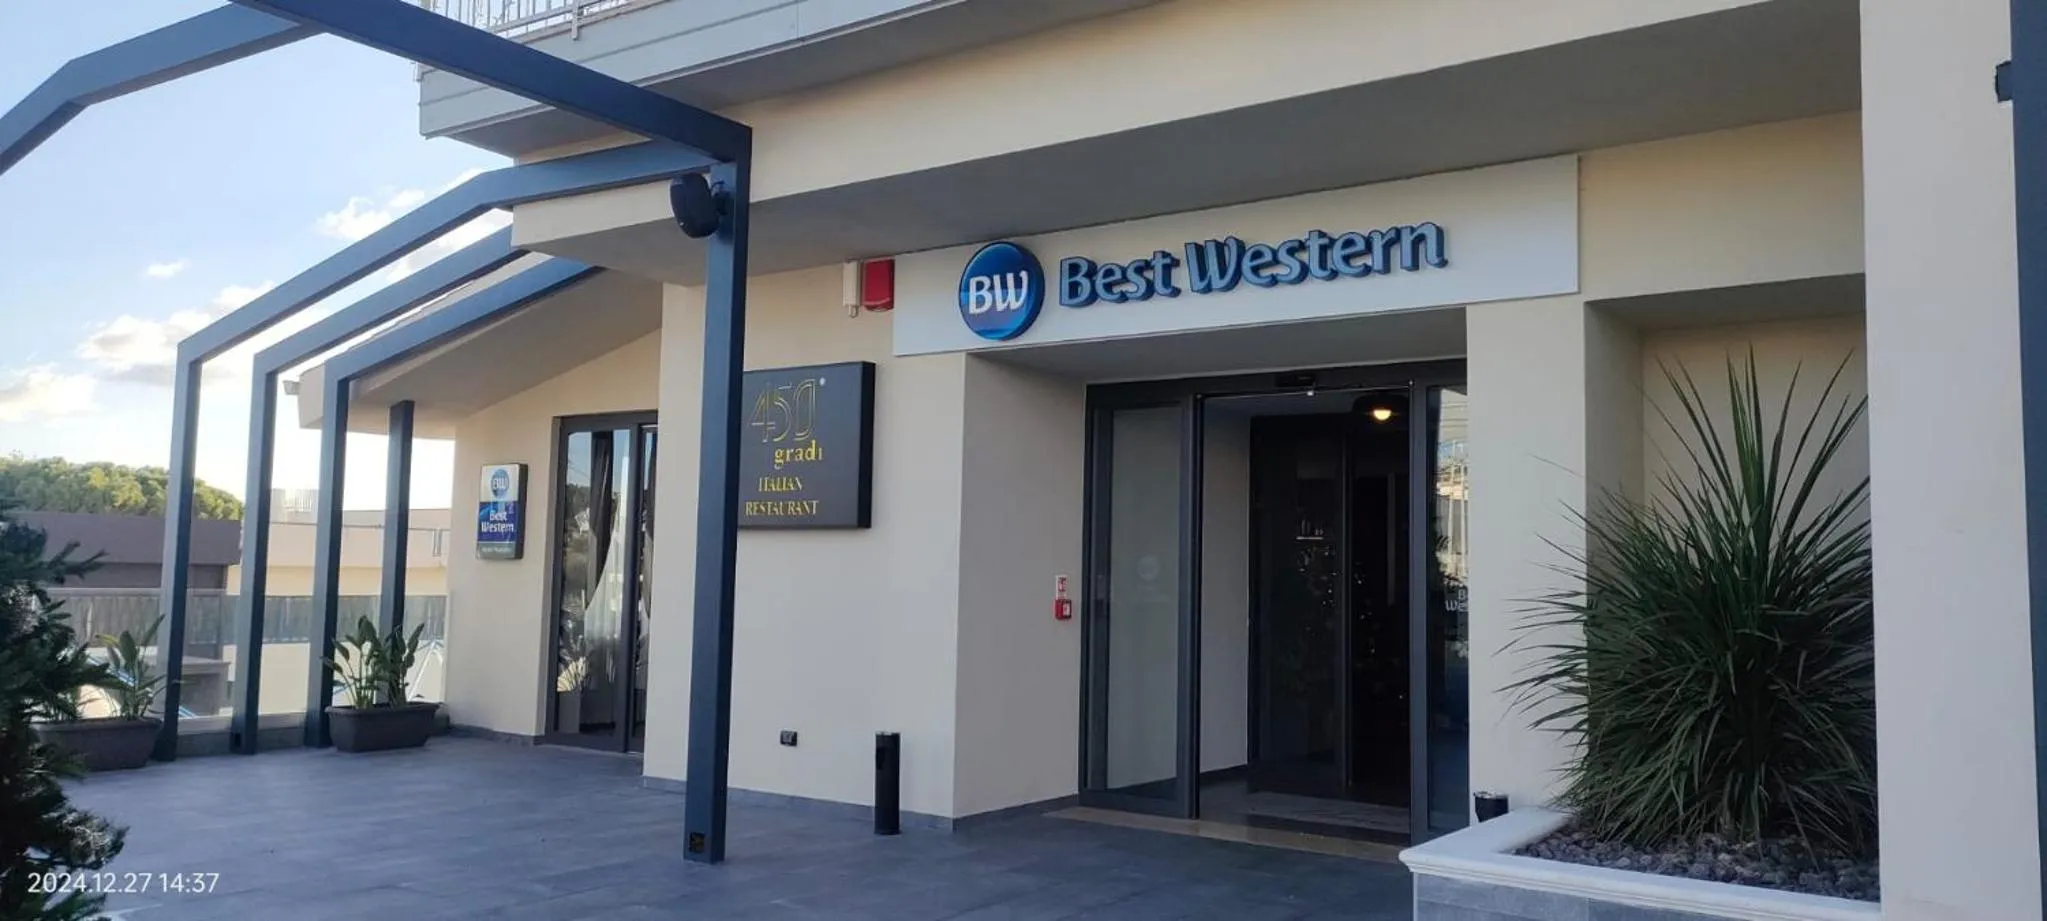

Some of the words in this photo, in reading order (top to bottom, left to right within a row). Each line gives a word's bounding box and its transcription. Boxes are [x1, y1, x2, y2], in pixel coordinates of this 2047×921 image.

[969, 271, 1029, 314] BW
[1059, 250, 1181, 308] Best
[1184, 221, 1449, 294] Western
[774, 439, 823, 470] gradi
[758, 476, 803, 492] ITALIAN
[489, 511, 507, 521] Best
[745, 500, 819, 516] RESTAURANT
[481, 522, 514, 532] Western
